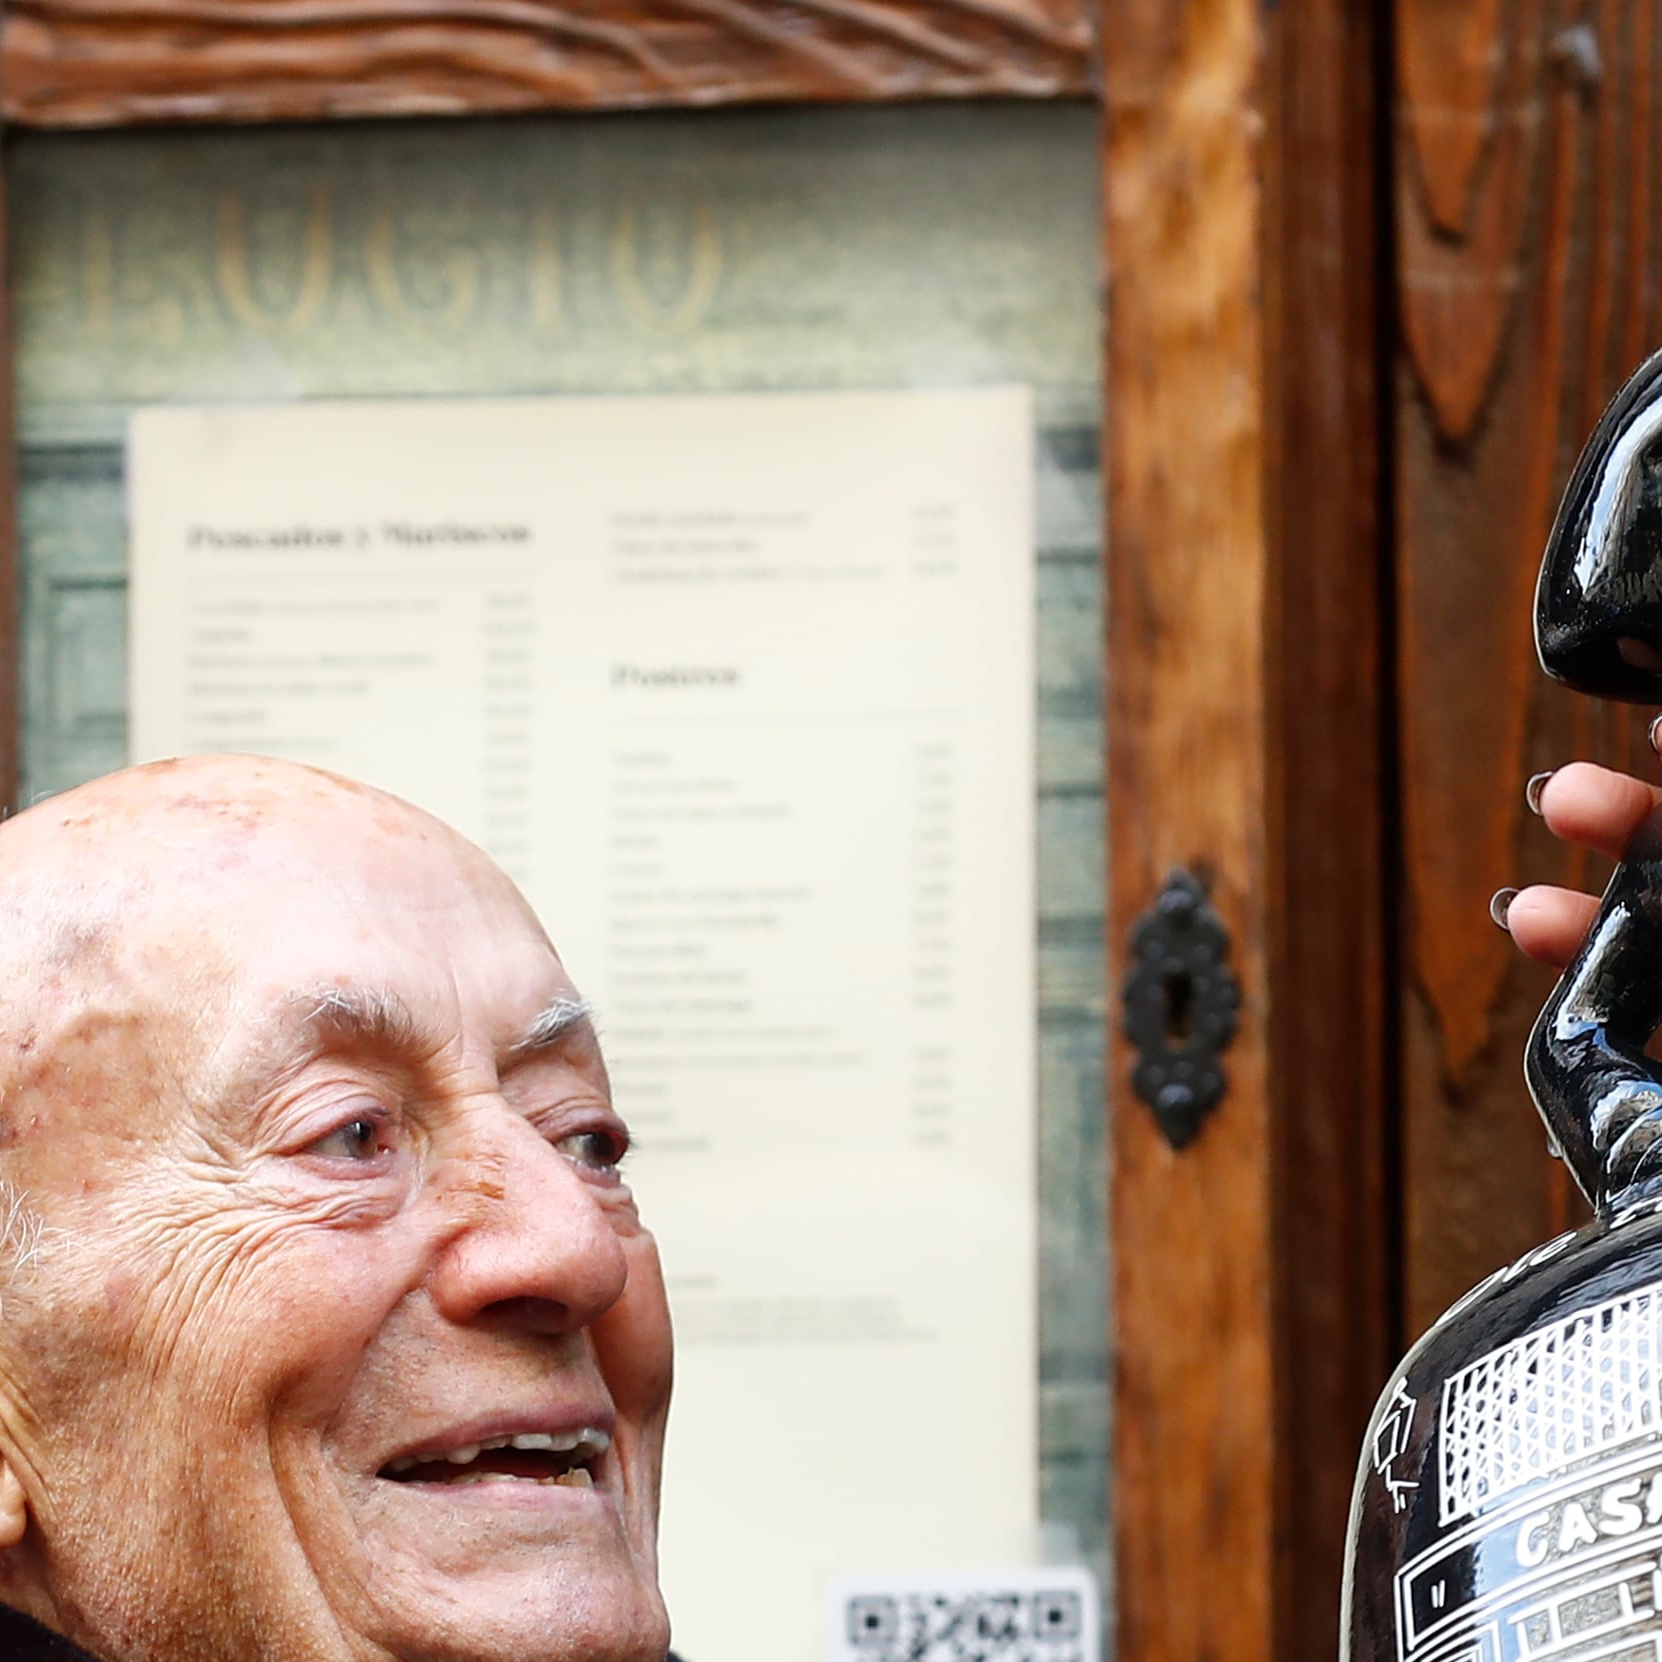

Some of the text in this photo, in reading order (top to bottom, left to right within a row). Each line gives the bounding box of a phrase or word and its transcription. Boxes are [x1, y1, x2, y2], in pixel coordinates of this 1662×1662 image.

[187, 523, 345, 551] Pescados
[380, 519, 533, 547] Mariscos
[610, 661, 741, 688] Postres
